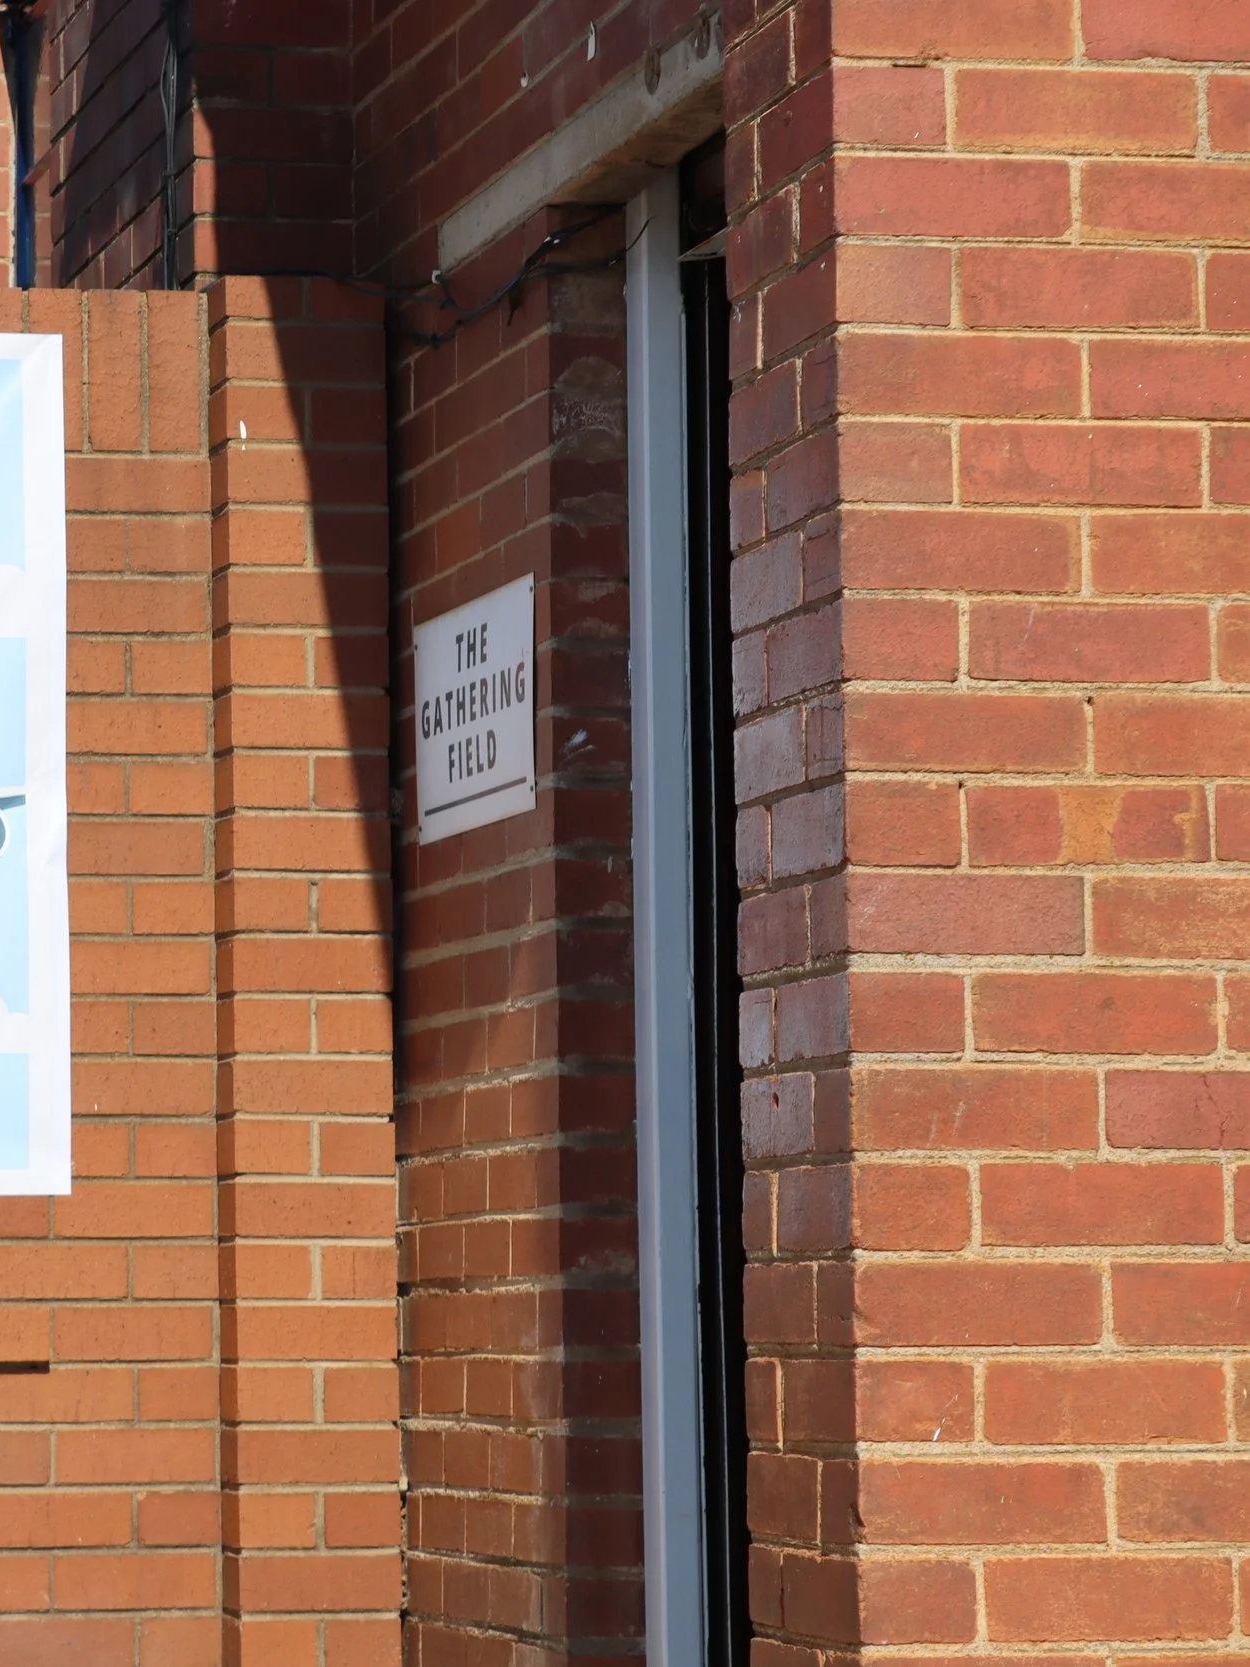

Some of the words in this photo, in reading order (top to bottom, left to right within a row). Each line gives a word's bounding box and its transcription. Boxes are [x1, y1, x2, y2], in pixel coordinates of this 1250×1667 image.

[455, 622, 488, 673] THE
[421, 661, 526, 740] GATHERING
[448, 728, 497, 784] FIELD
